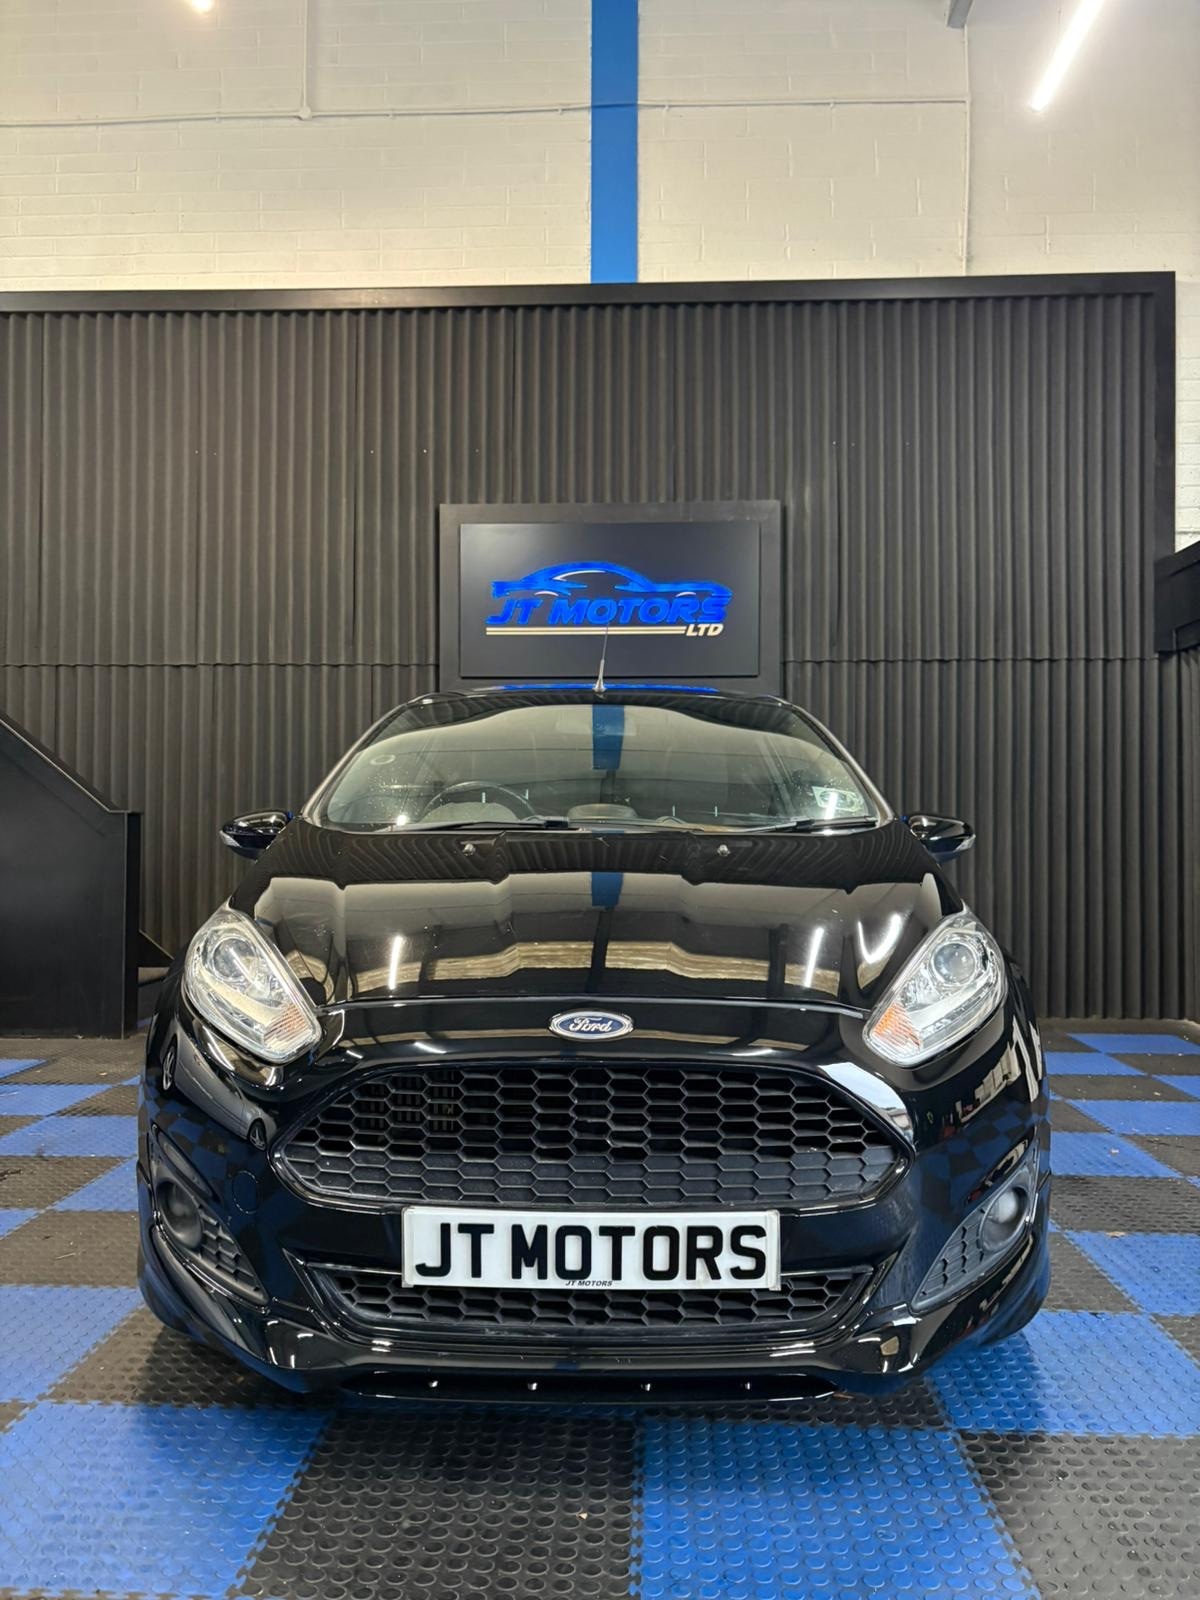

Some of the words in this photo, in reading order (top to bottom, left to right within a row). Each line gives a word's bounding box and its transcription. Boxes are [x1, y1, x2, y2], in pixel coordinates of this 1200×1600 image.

[485, 598, 543, 625] JT
[548, 597, 731, 625] MOTORS
[685, 623, 724, 637] LTD
[569, 1017, 613, 1032] Ford
[415, 1222, 495, 1279] JT
[511, 1223, 767, 1281] MOTORS
